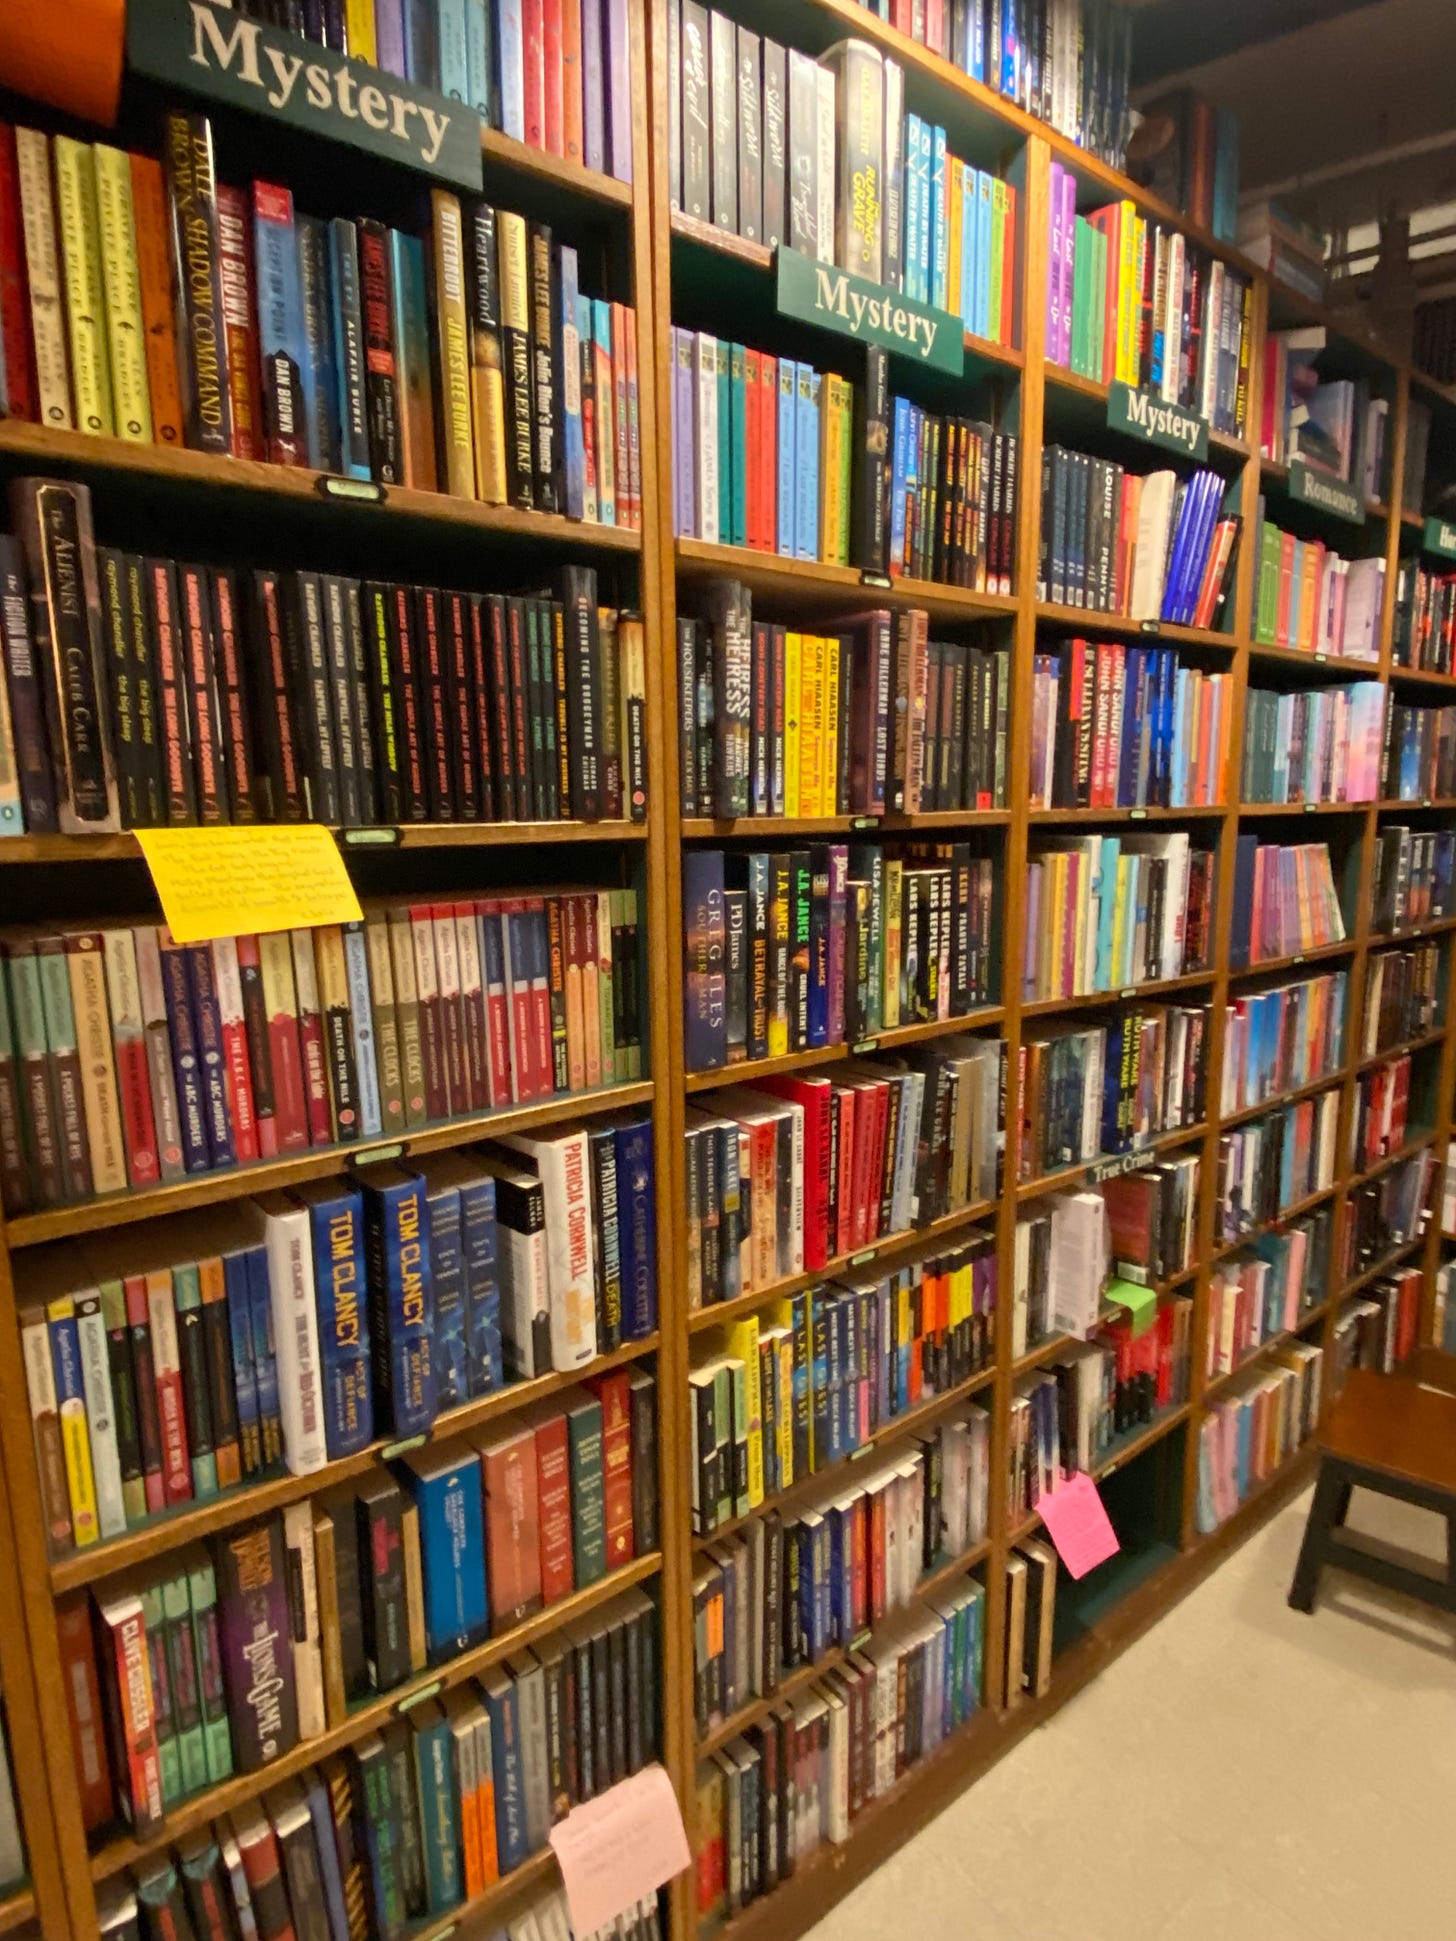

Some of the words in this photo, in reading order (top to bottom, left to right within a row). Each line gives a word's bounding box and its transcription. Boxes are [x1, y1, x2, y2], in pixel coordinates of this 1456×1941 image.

[189, 2, 451, 164] Mystery
[193, 137, 211, 199] DALE
[852, 170, 867, 234] GRAVE
[863, 164, 876, 246] RUNNING
[921, 182, 929, 219] DEATH
[219, 213, 245, 253] DAN
[921, 221, 929, 234] BY
[186, 218, 213, 310] SHADOW
[441, 210, 463, 304] BITTERROOT
[474, 215, 497, 326] Heartwood
[221, 258, 249, 327] BROWN
[534, 282, 551, 303] LEE
[815, 269, 937, 356] Mystery
[347, 320, 361, 382] ALAFAIR
[446, 316, 468, 369] JAMES
[511, 332, 529, 383] JAMES
[193, 311, 223, 426] COMMAND
[275, 358, 292, 384] DAN
[449, 371, 467, 398] LEE
[277, 388, 294, 434] BROWN
[351, 388, 363, 434] BURKE
[513, 387, 529, 418] LEE
[1127, 389, 1200, 450] Mystery
[452, 400, 470, 449] BURKE
[515, 420, 532, 474] BURKE
[538, 425, 555, 474] Bounce
[993, 435, 1003, 473] ROBERT
[1103, 466, 1115, 520] LOUISE
[1304, 472, 1358, 516] Romance
[54, 535, 79, 618] ALIENIST
[1099, 547, 1109, 594] PENNY
[3, 596, 28, 636] FICTION
[577, 597, 590, 653] BECOMING
[683, 627, 692, 640] THE
[726, 609, 737, 629] THE
[9, 638, 33, 677] WRITER
[814, 646, 823, 674] CARL
[880, 628, 890, 656] ANNE
[67, 647, 84, 701] CALEB
[580, 659, 590, 679] THE
[725, 631, 741, 714] HEIRESS
[739, 638, 751, 718] HEIRESS
[829, 648, 839, 677] CARL
[1100, 650, 1113, 690] JOHN
[1113, 651, 1126, 689] JOHN
[683, 641, 694, 731] HOUSEKEEPERS
[814, 679, 823, 730] HIAASEN
[878, 659, 889, 715] HILLERMAN
[581, 684, 593, 748] BOOGEYMAN
[631, 705, 641, 732] DEATH
[699, 693, 708, 728] TRAIN
[757, 707, 766, 732] ROAD
[775, 708, 783, 733] ROAD
[828, 681, 838, 731] HIAASEN
[73, 706, 91, 752] CARR
[633, 736, 641, 747] ON
[758, 736, 766, 758] MICK
[775, 737, 783, 758] MICK
[877, 726, 888, 750] LOST
[1096, 693, 1111, 767] SANDFORD
[1108, 692, 1122, 767] SANDFORD
[633, 749, 642, 764] THE
[725, 733, 736, 777] HAWKINS
[876, 753, 887, 782] BIRDS
[633, 766, 642, 786] NILE
[758, 760, 766, 795] HERRON
[775, 760, 783, 794] HERRON
[755, 861, 765, 881] J.A.
[777, 870, 789, 895] J.A.
[797, 869, 810, 895] J.A.
[872, 856, 881, 892] LISA
[755, 887, 765, 931] JANCE
[909, 878, 918, 909] LARS
[929, 877, 939, 908] LARS
[941, 876, 951, 907] LARS
[550, 902, 561, 944] AGATHA
[707, 888, 721, 960] GREG
[776, 897, 789, 940] JANCE
[796, 898, 810, 943] JANCE
[871, 893, 880, 944] JEWELL
[909, 913, 918, 960] KEPLER
[929, 911, 939, 957] KEPLER
[940, 911, 950, 956] KEPLER
[958, 912, 968, 950] PRAGUE
[696, 904, 707, 979] SOUTHERN
[818, 937, 826, 955] J.A.
[551, 947, 563, 992] CHRISTIE
[753, 939, 766, 1001] BETRAYAL
[799, 973, 807, 1000] CRUEL
[818, 955, 826, 987] JANCE
[957, 955, 968, 990] FATALE
[699, 993, 708, 1020] MAN
[709, 973, 722, 1028] ILES
[777, 983, 787, 999] THE
[332, 1017, 347, 1047] DEATH
[381, 1023, 397, 1045] THE
[402, 1020, 419, 1042] THE
[754, 1007, 766, 1041] TRUST
[799, 1001, 807, 1031] INTENT
[1122, 1017, 1132, 1053] RUTH
[1132, 1015, 1144, 1051] RUTH
[335, 1049, 347, 1060] ON
[337, 1063, 348, 1081] THE
[383, 1047, 399, 1087] CLOCKS
[406, 1044, 422, 1084] CLOCKS
[1120, 1056, 1131, 1089] WARE
[1130, 1052, 1141, 1086] WARE
[185, 1084, 198, 1104] ABC
[210, 1080, 223, 1100] ABC
[230, 1036, 242, 1054] THE
[236, 1087, 251, 1131] MURDERS
[339, 1083, 350, 1104] NILE
[187, 1105, 203, 1147] MURDERS
[211, 1100, 228, 1142] MURDERS
[727, 1134, 738, 1157] IRON
[563, 1143, 585, 1206] PATRICIA
[727, 1163, 738, 1190] LAKE
[1094, 1163, 1120, 1182] True
[1123, 1151, 1155, 1173] Crime
[601, 1160, 618, 1218] PATRICIA
[329, 1209, 353, 1260] TOM
[396, 1193, 420, 1241] TOM
[567, 1206, 588, 1282] CORNWELL
[602, 1217, 620, 1283] CORNWELL
[399, 1242, 424, 1327] CLANCY
[295, 1313, 309, 1332] THE
[333, 1260, 359, 1348] CLANCY
[605, 1283, 621, 1327] DEATH
[847, 1304, 855, 1330] MAYBE
[59, 1328, 73, 1360] Agatha
[750, 1327, 758, 1361] LAURA
[831, 1312, 839, 1338] MAYBE
[297, 1333, 311, 1359] HUNT
[831, 1339, 839, 1361] NEXT
[848, 1354, 856, 1372] TIME
[63, 1361, 77, 1398] Christie
[750, 1362, 759, 1415] LIPPMAN
[831, 1363, 839, 1381] TIME
[344, 1375, 358, 1433] DEFIANCE
[357, 1384, 368, 1400] OF
[752, 1435, 760, 1465] Prom
[832, 1421, 840, 1449] MAJOR
[783, 1433, 791, 1477] LIPPMAN
[753, 1466, 761, 1490] Mom
[121, 1619, 144, 1655] CLIVE
[247, 1678, 285, 1740] GAME
